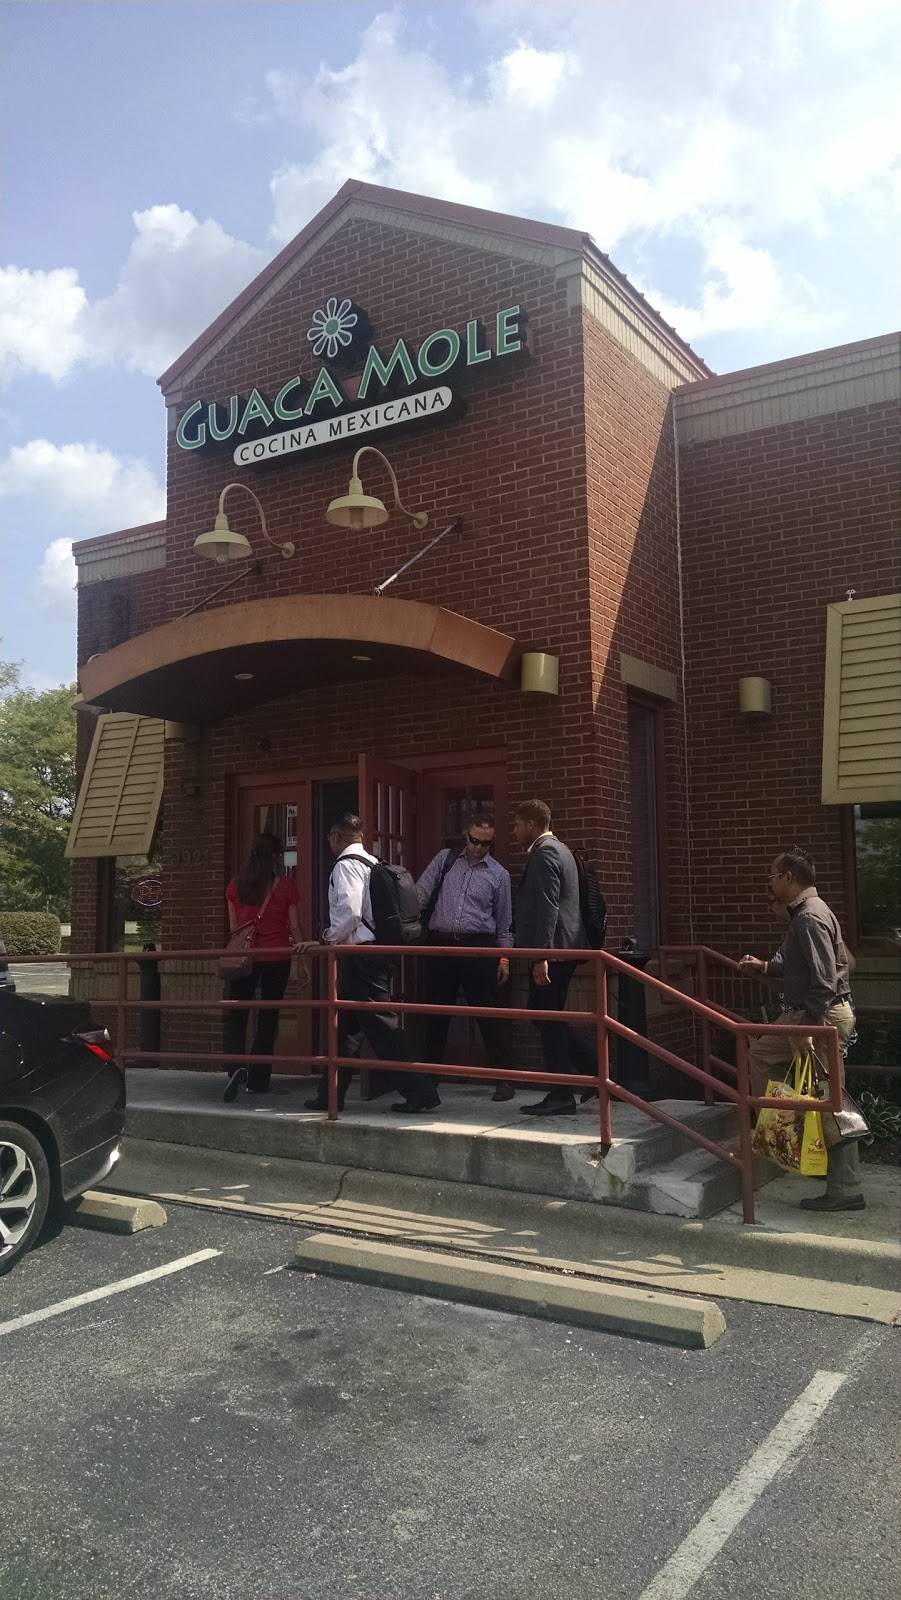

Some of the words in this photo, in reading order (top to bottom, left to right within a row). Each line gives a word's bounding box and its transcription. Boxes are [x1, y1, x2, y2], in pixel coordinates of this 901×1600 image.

[175, 366, 344, 450] GUACA
[357, 304, 522, 400] MOLE
[239, 428, 317, 462] COCINA
[328, 391, 445, 438] MEXICANA
